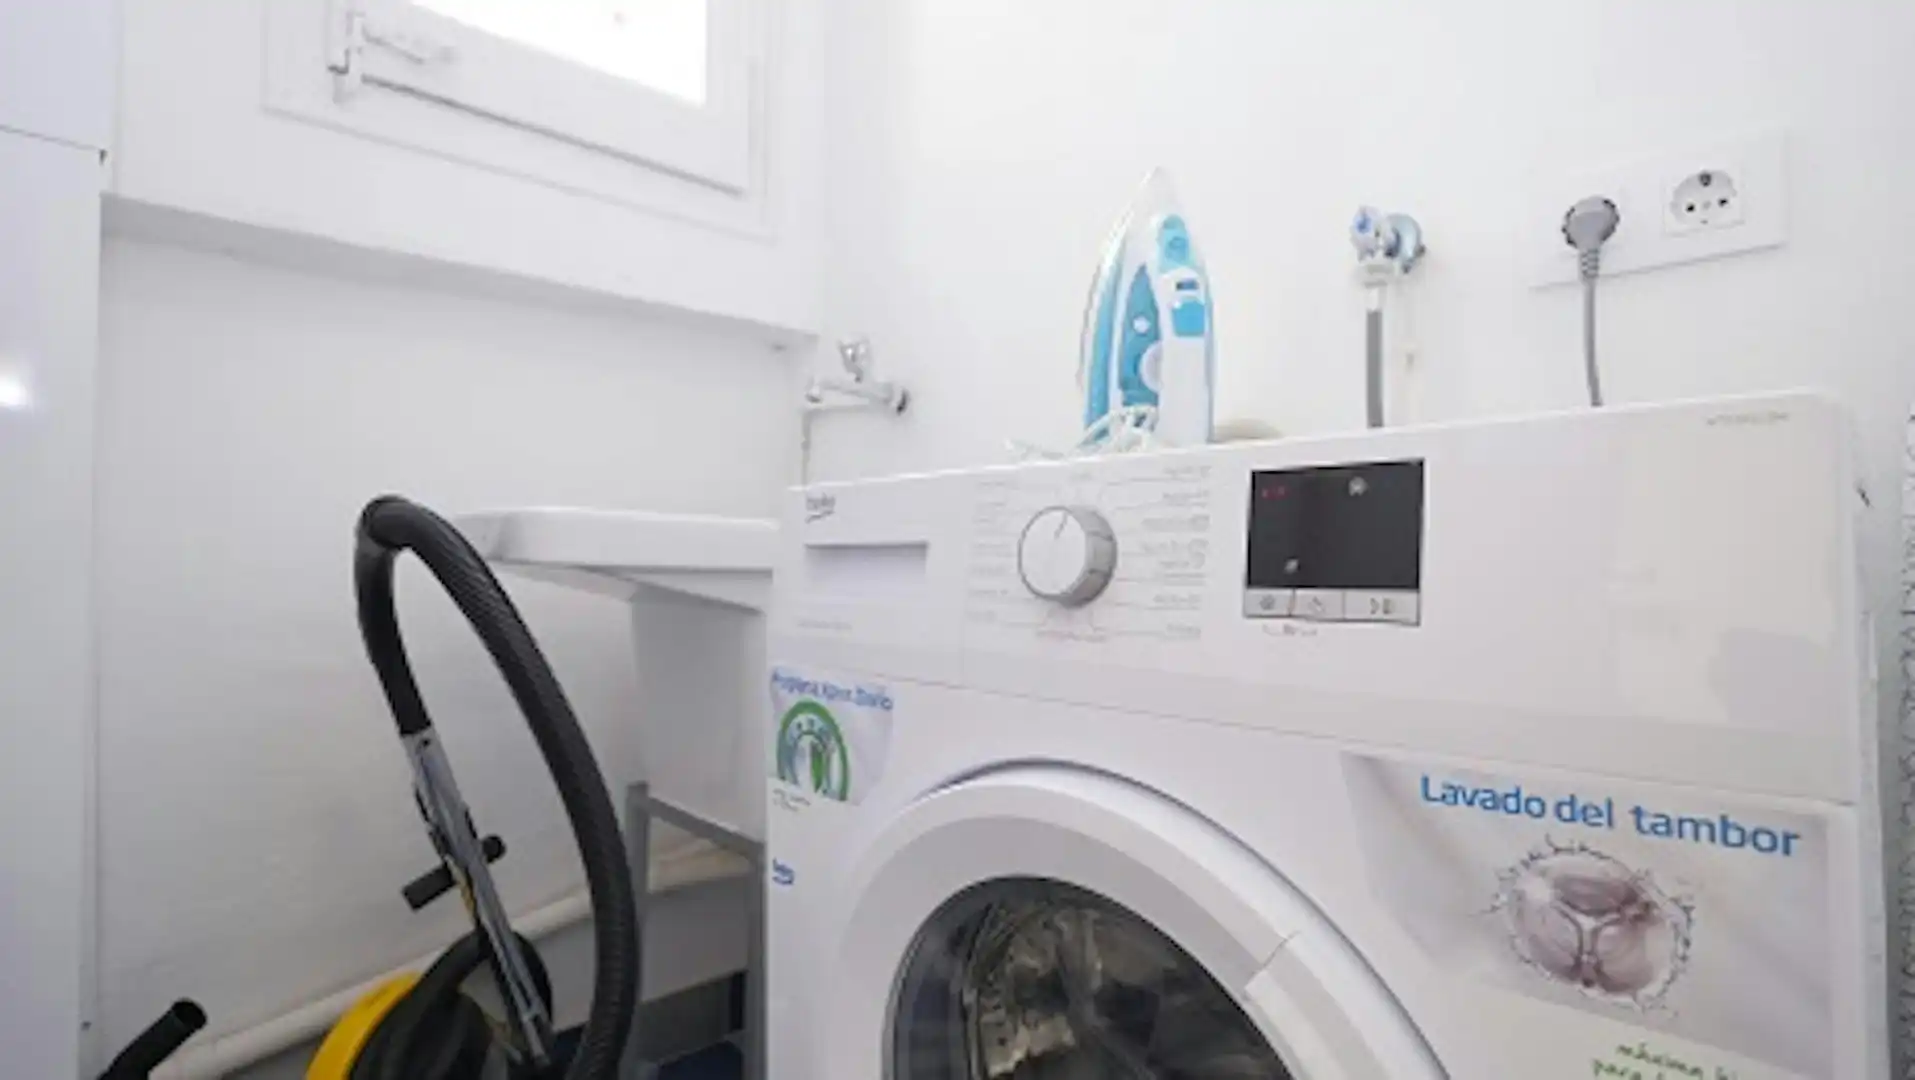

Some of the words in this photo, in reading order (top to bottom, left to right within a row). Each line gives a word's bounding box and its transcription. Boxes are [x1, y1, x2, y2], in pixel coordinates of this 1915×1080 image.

[1420, 774, 1547, 819] Lavado
[1554, 793, 1616, 830] del
[1629, 805, 1801, 857] tambor
